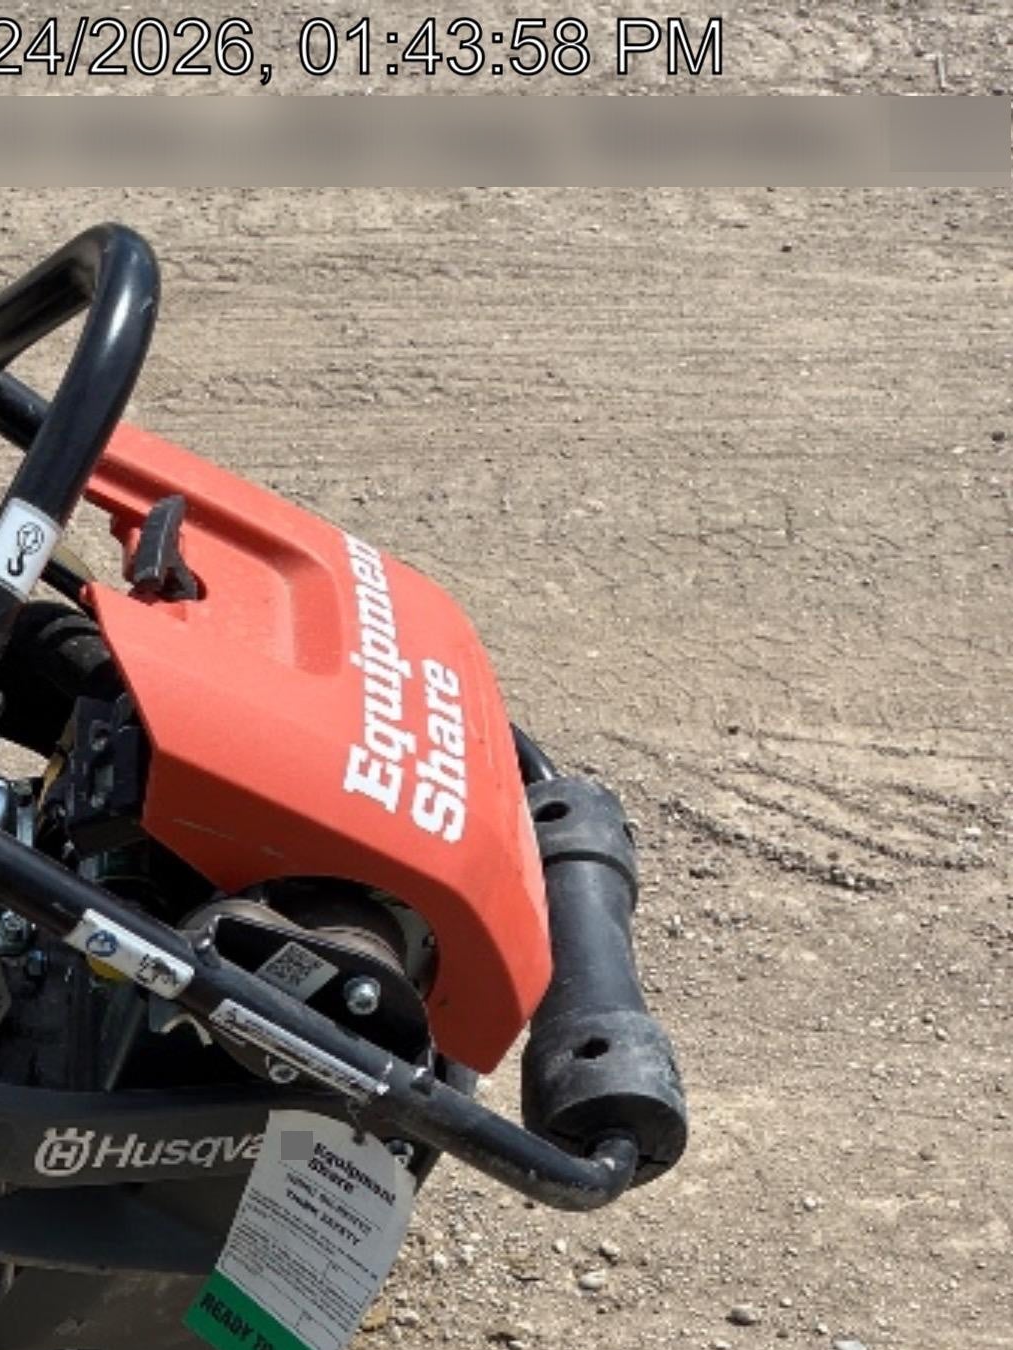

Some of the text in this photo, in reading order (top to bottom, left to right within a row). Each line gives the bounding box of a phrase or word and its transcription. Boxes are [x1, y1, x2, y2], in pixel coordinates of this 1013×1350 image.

[343, 531, 416, 813] Equipmen
[410, 658, 468, 843] Share
[91, 1133, 267, 1168] Husqva
[308, 1157, 354, 1194] Share
[313, 1142, 396, 1206] Equipment
[199, 1291, 255, 1342] READY
